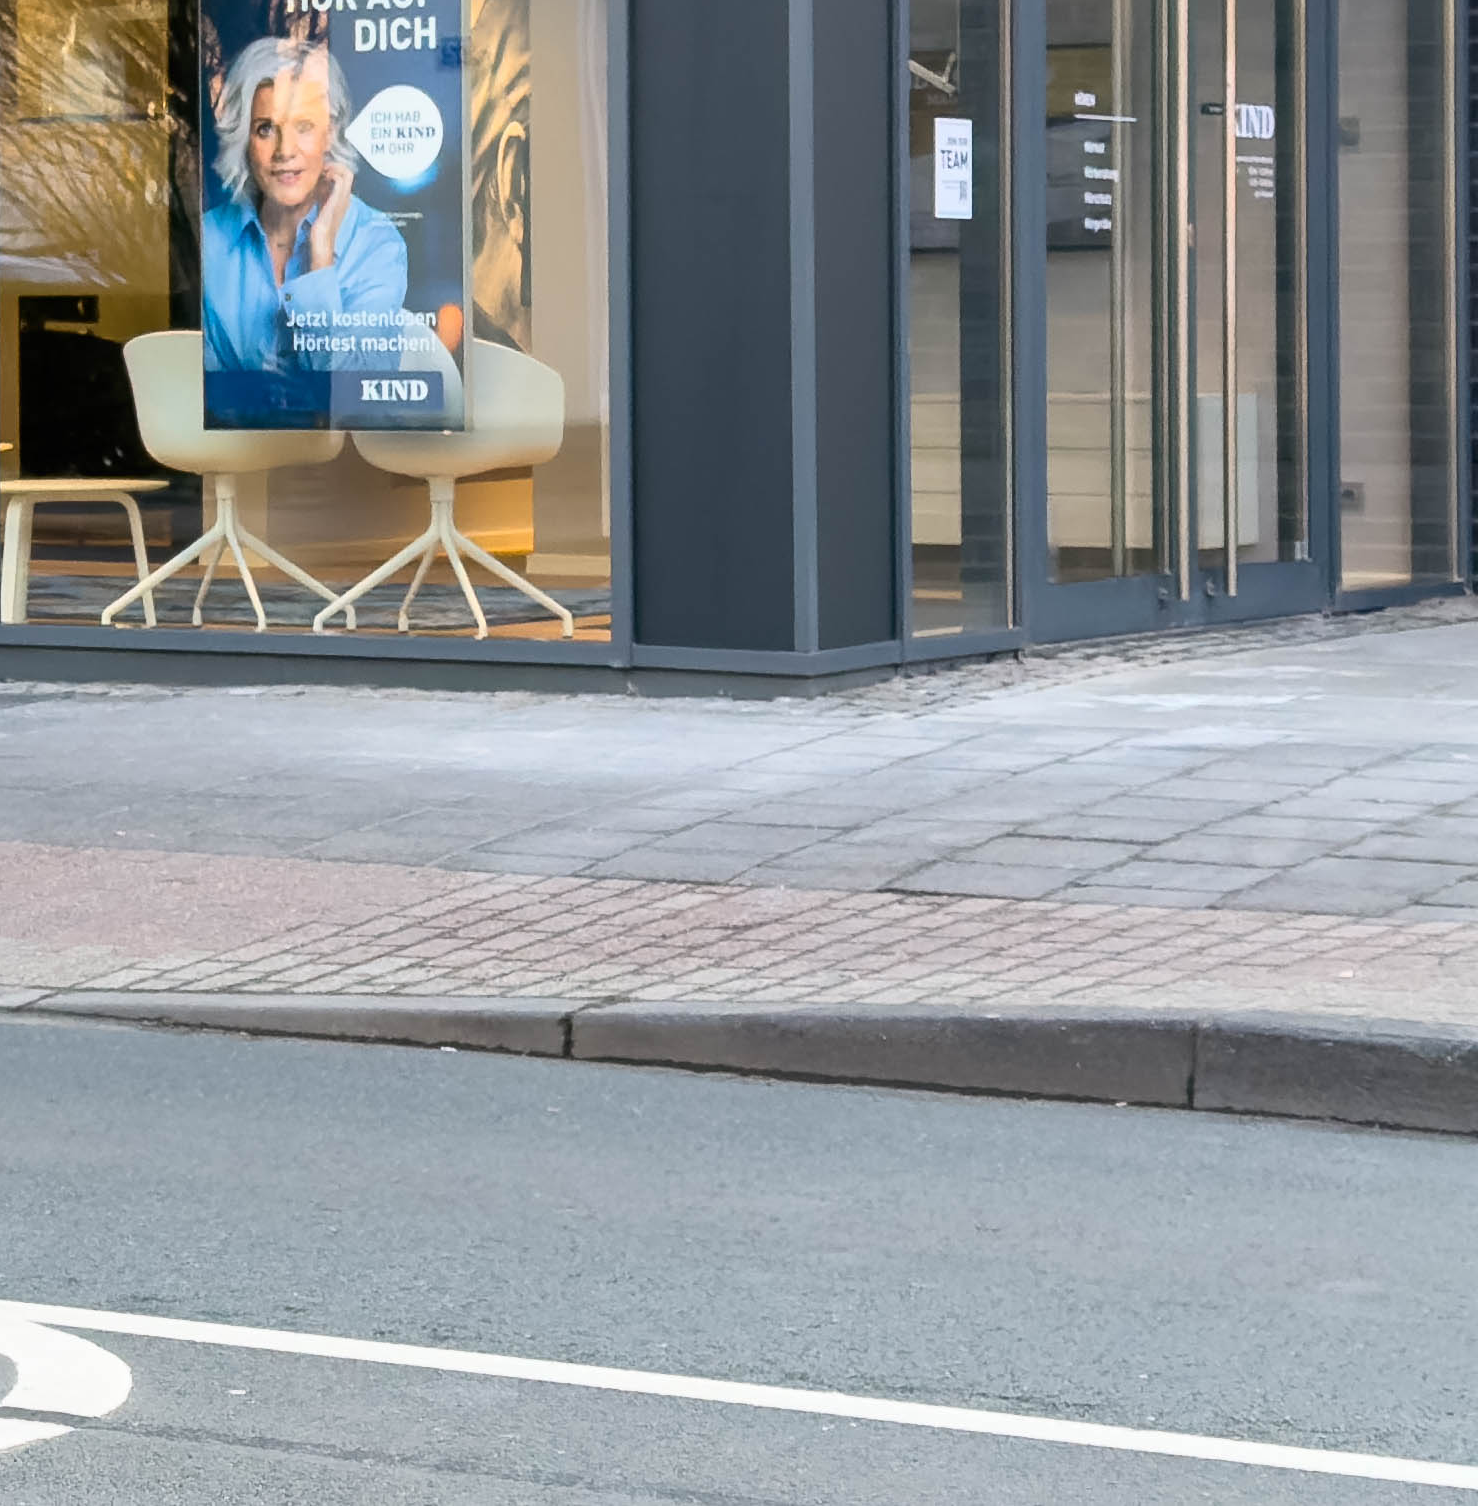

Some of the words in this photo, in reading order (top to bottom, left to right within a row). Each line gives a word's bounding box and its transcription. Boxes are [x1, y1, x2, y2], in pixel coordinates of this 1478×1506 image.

[354, 17, 438, 52] DICH
[371, 111, 391, 123] ICH
[1236, 104, 1275, 139] IND
[371, 128, 392, 140] EIN
[397, 127, 436, 139] KIND
[940, 150, 968, 169] TEAM
[286, 309, 328, 330] Jetzt
[332, 309, 438, 328] kostenlosen
[292, 332, 357, 353] Hörtest
[360, 332, 438, 353] machen!
[360, 379, 429, 402] KIND
